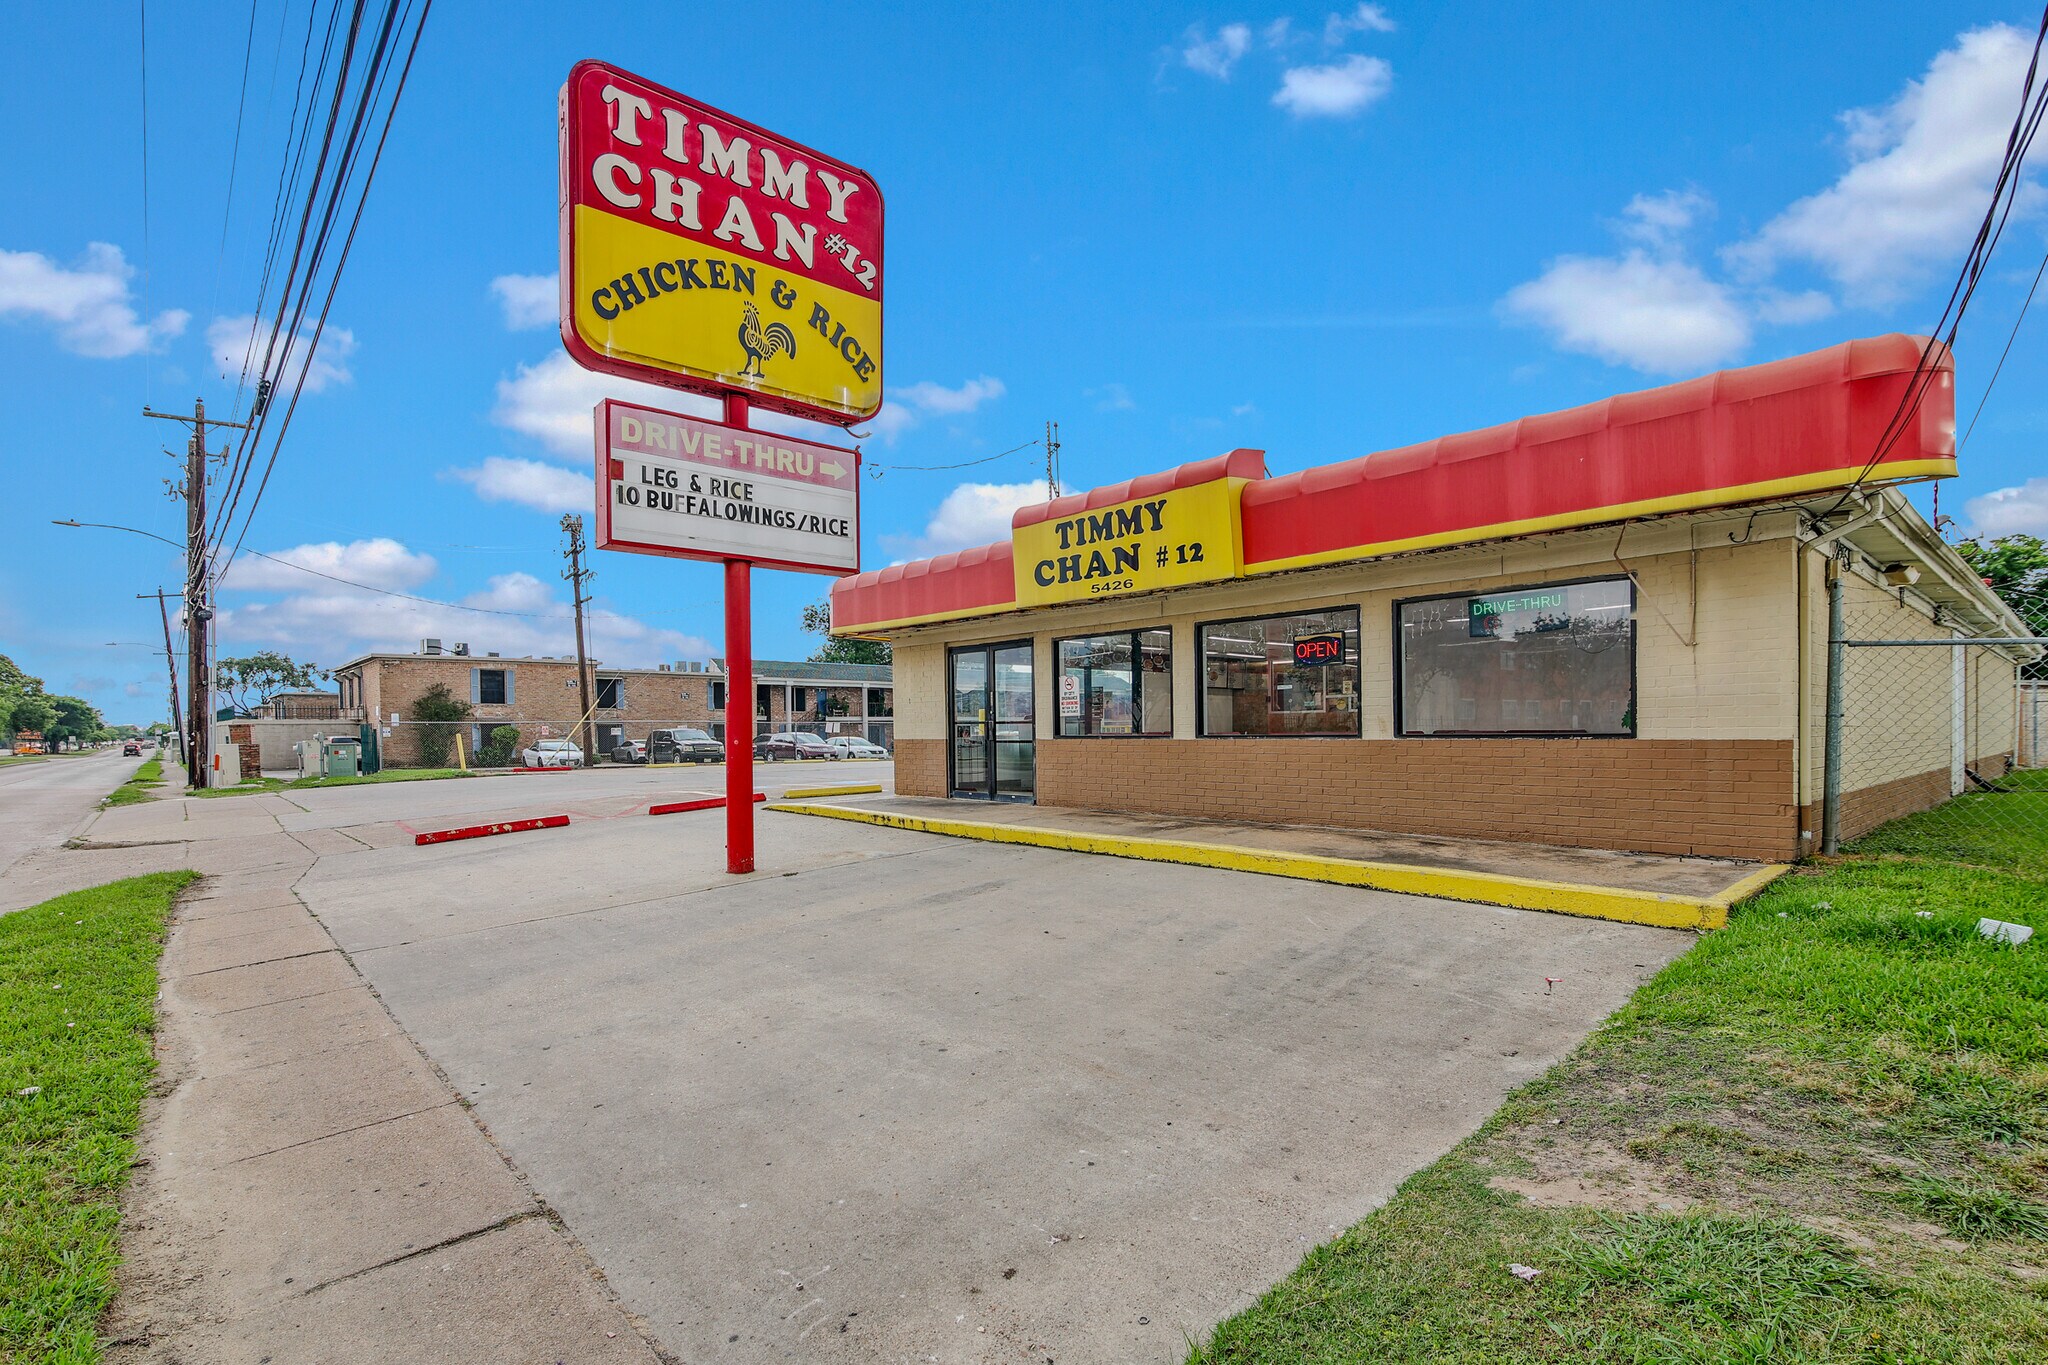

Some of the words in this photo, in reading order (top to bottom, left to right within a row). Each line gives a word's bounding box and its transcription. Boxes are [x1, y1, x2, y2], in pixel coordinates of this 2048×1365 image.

[601, 84, 859, 224] TIMMY
[591, 152, 818, 270] CHAN
[823, 232, 878, 292] #12
[591, 258, 756, 321] CHICKEN
[770, 279, 797, 310] &
[808, 301, 876, 384] RICE
[621, 416, 814, 476] DRIVE-THRU
[641, 465, 678, 489] LEG
[690, 474, 702, 493] &
[710, 477, 754, 501] RICE
[1055, 499, 1168, 549] TIMMY
[1034, 542, 1141, 587] CHAN
[1176, 542, 1204, 564] 12
[1091, 578, 1134, 593] 5426
[1473, 594, 1561, 616] DRIVE-THRU
[1296, 640, 1339, 658] OPEN
